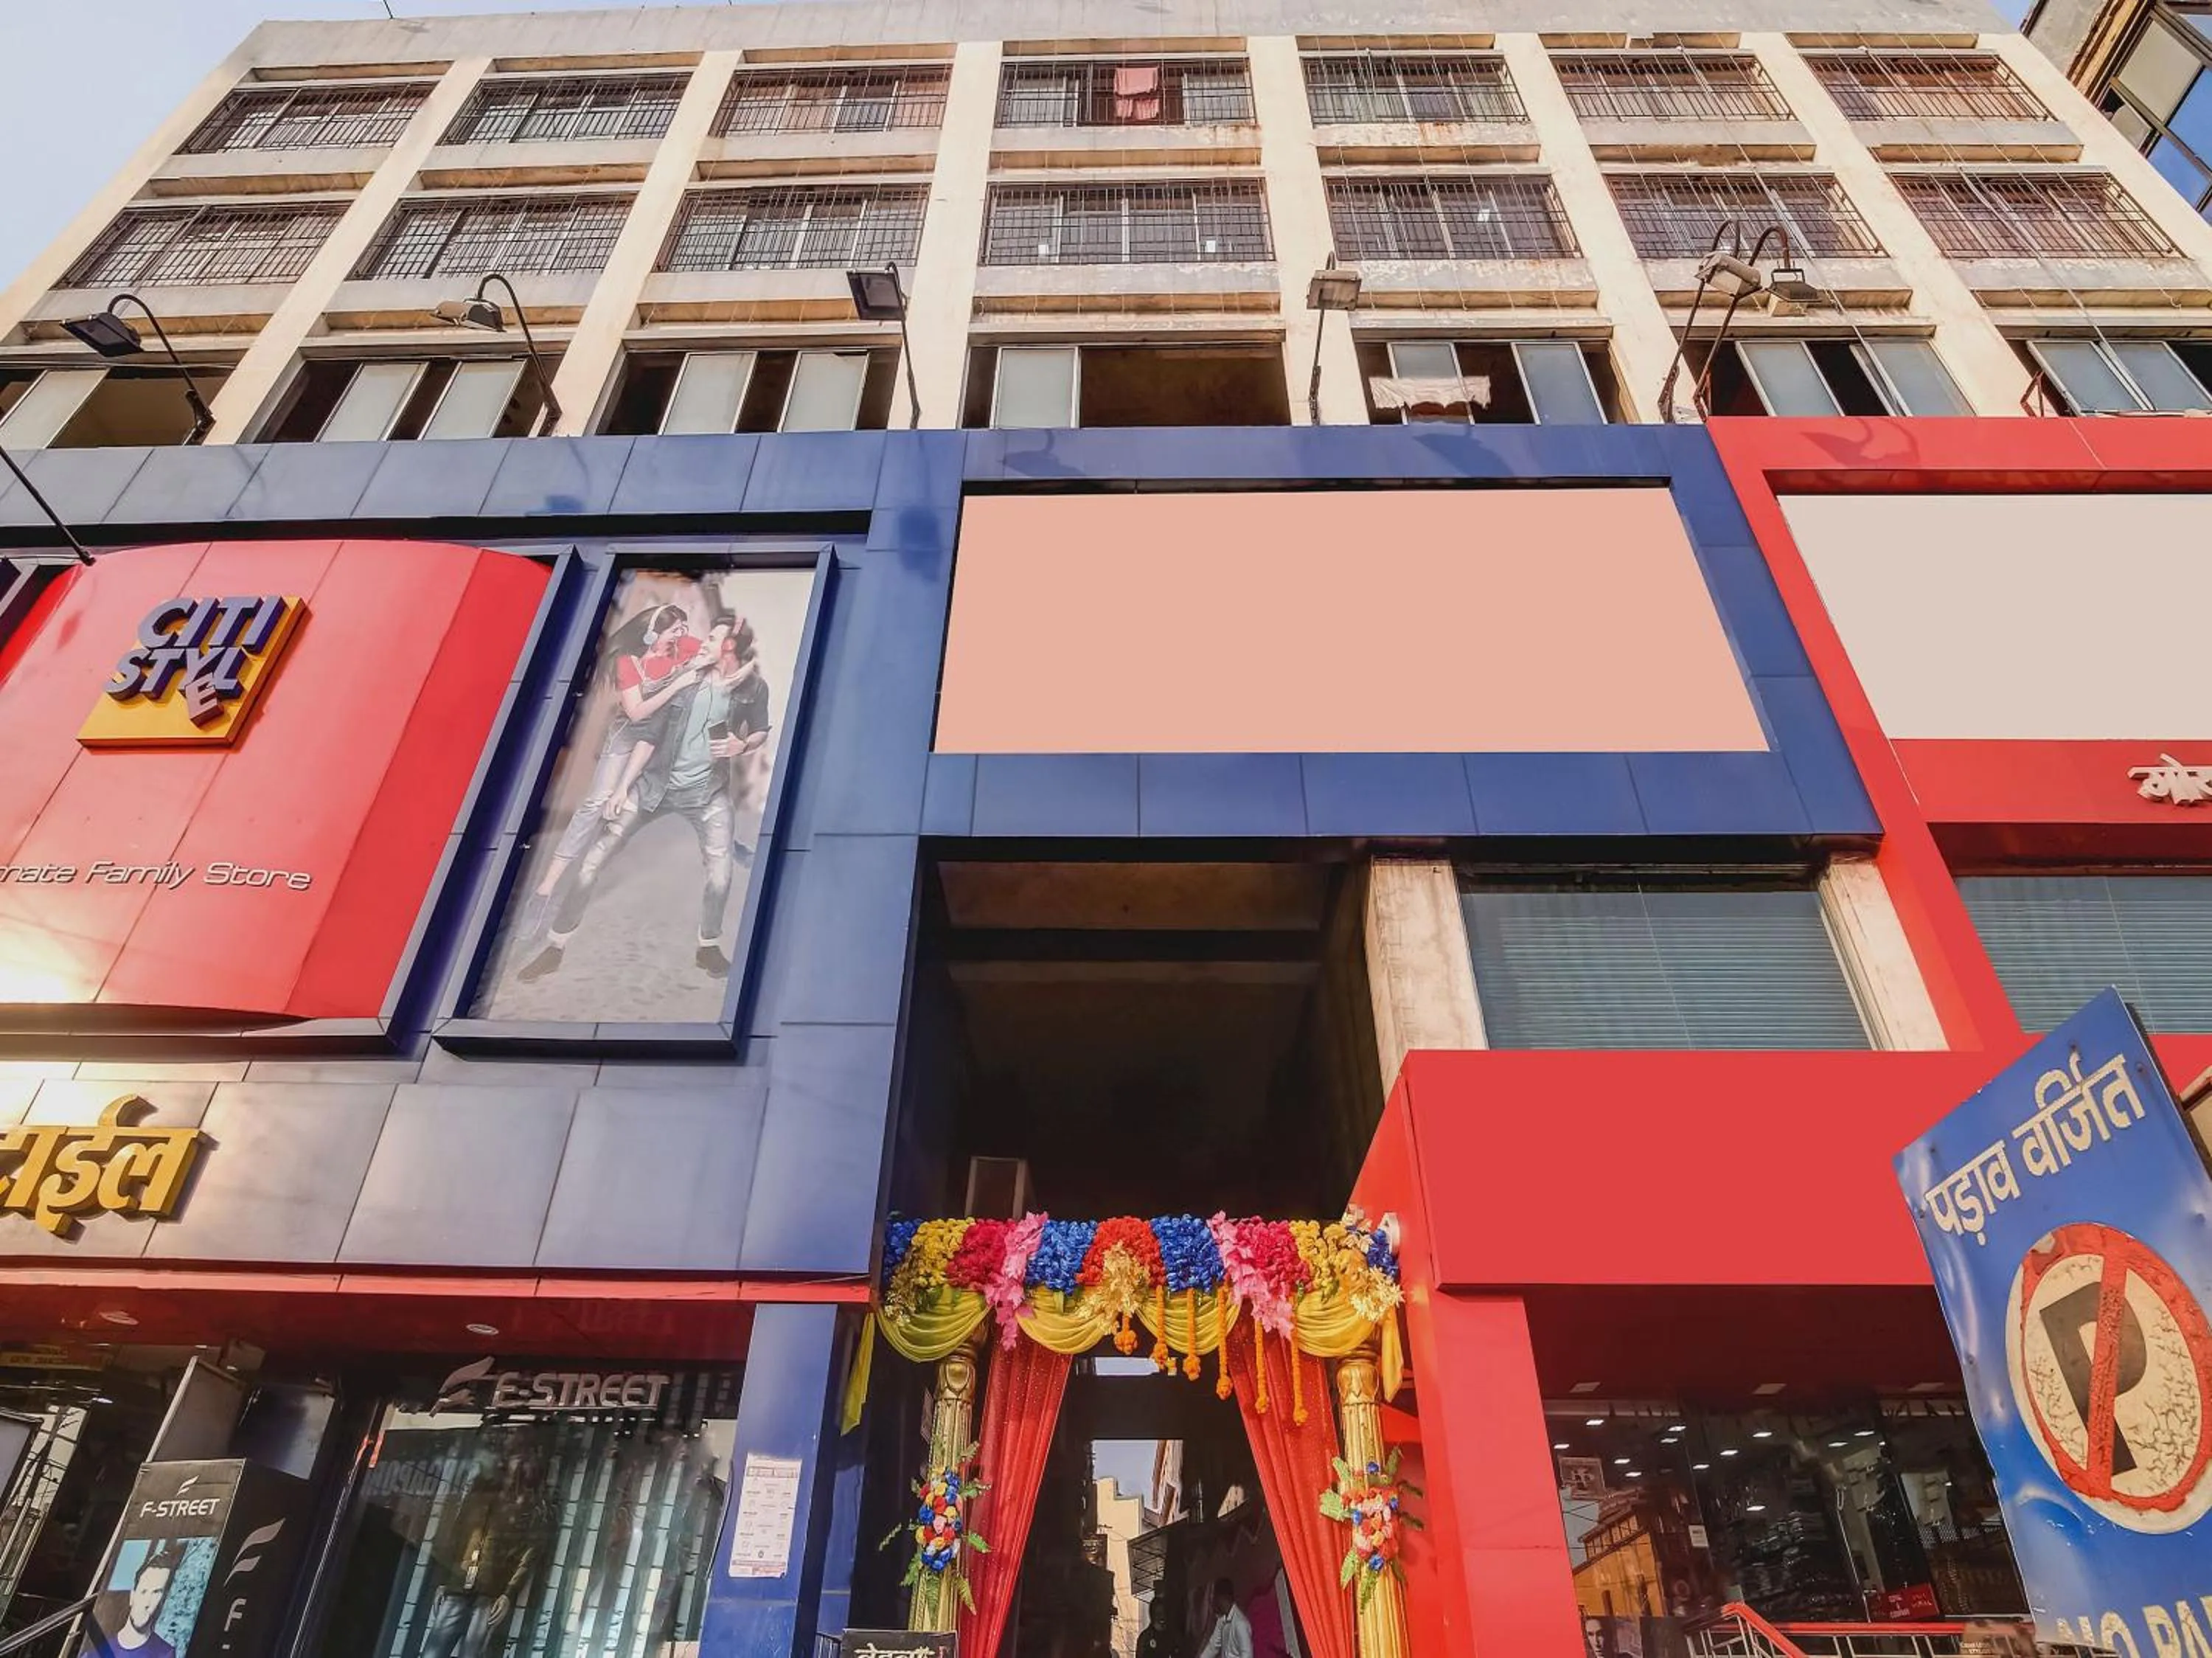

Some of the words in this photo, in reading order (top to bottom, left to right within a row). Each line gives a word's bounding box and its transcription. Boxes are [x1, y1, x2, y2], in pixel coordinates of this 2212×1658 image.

[137, 596, 288, 653] CITI
[86, 861, 194, 889] Family
[204, 861, 311, 889] Store
[1923, 1139, 2020, 1246] पड़ाव
[2011, 1051, 2146, 1178] वर्जित
[140, 1498, 220, 1519] F-STREET
[2142, 1595, 2212, 1658] PA
